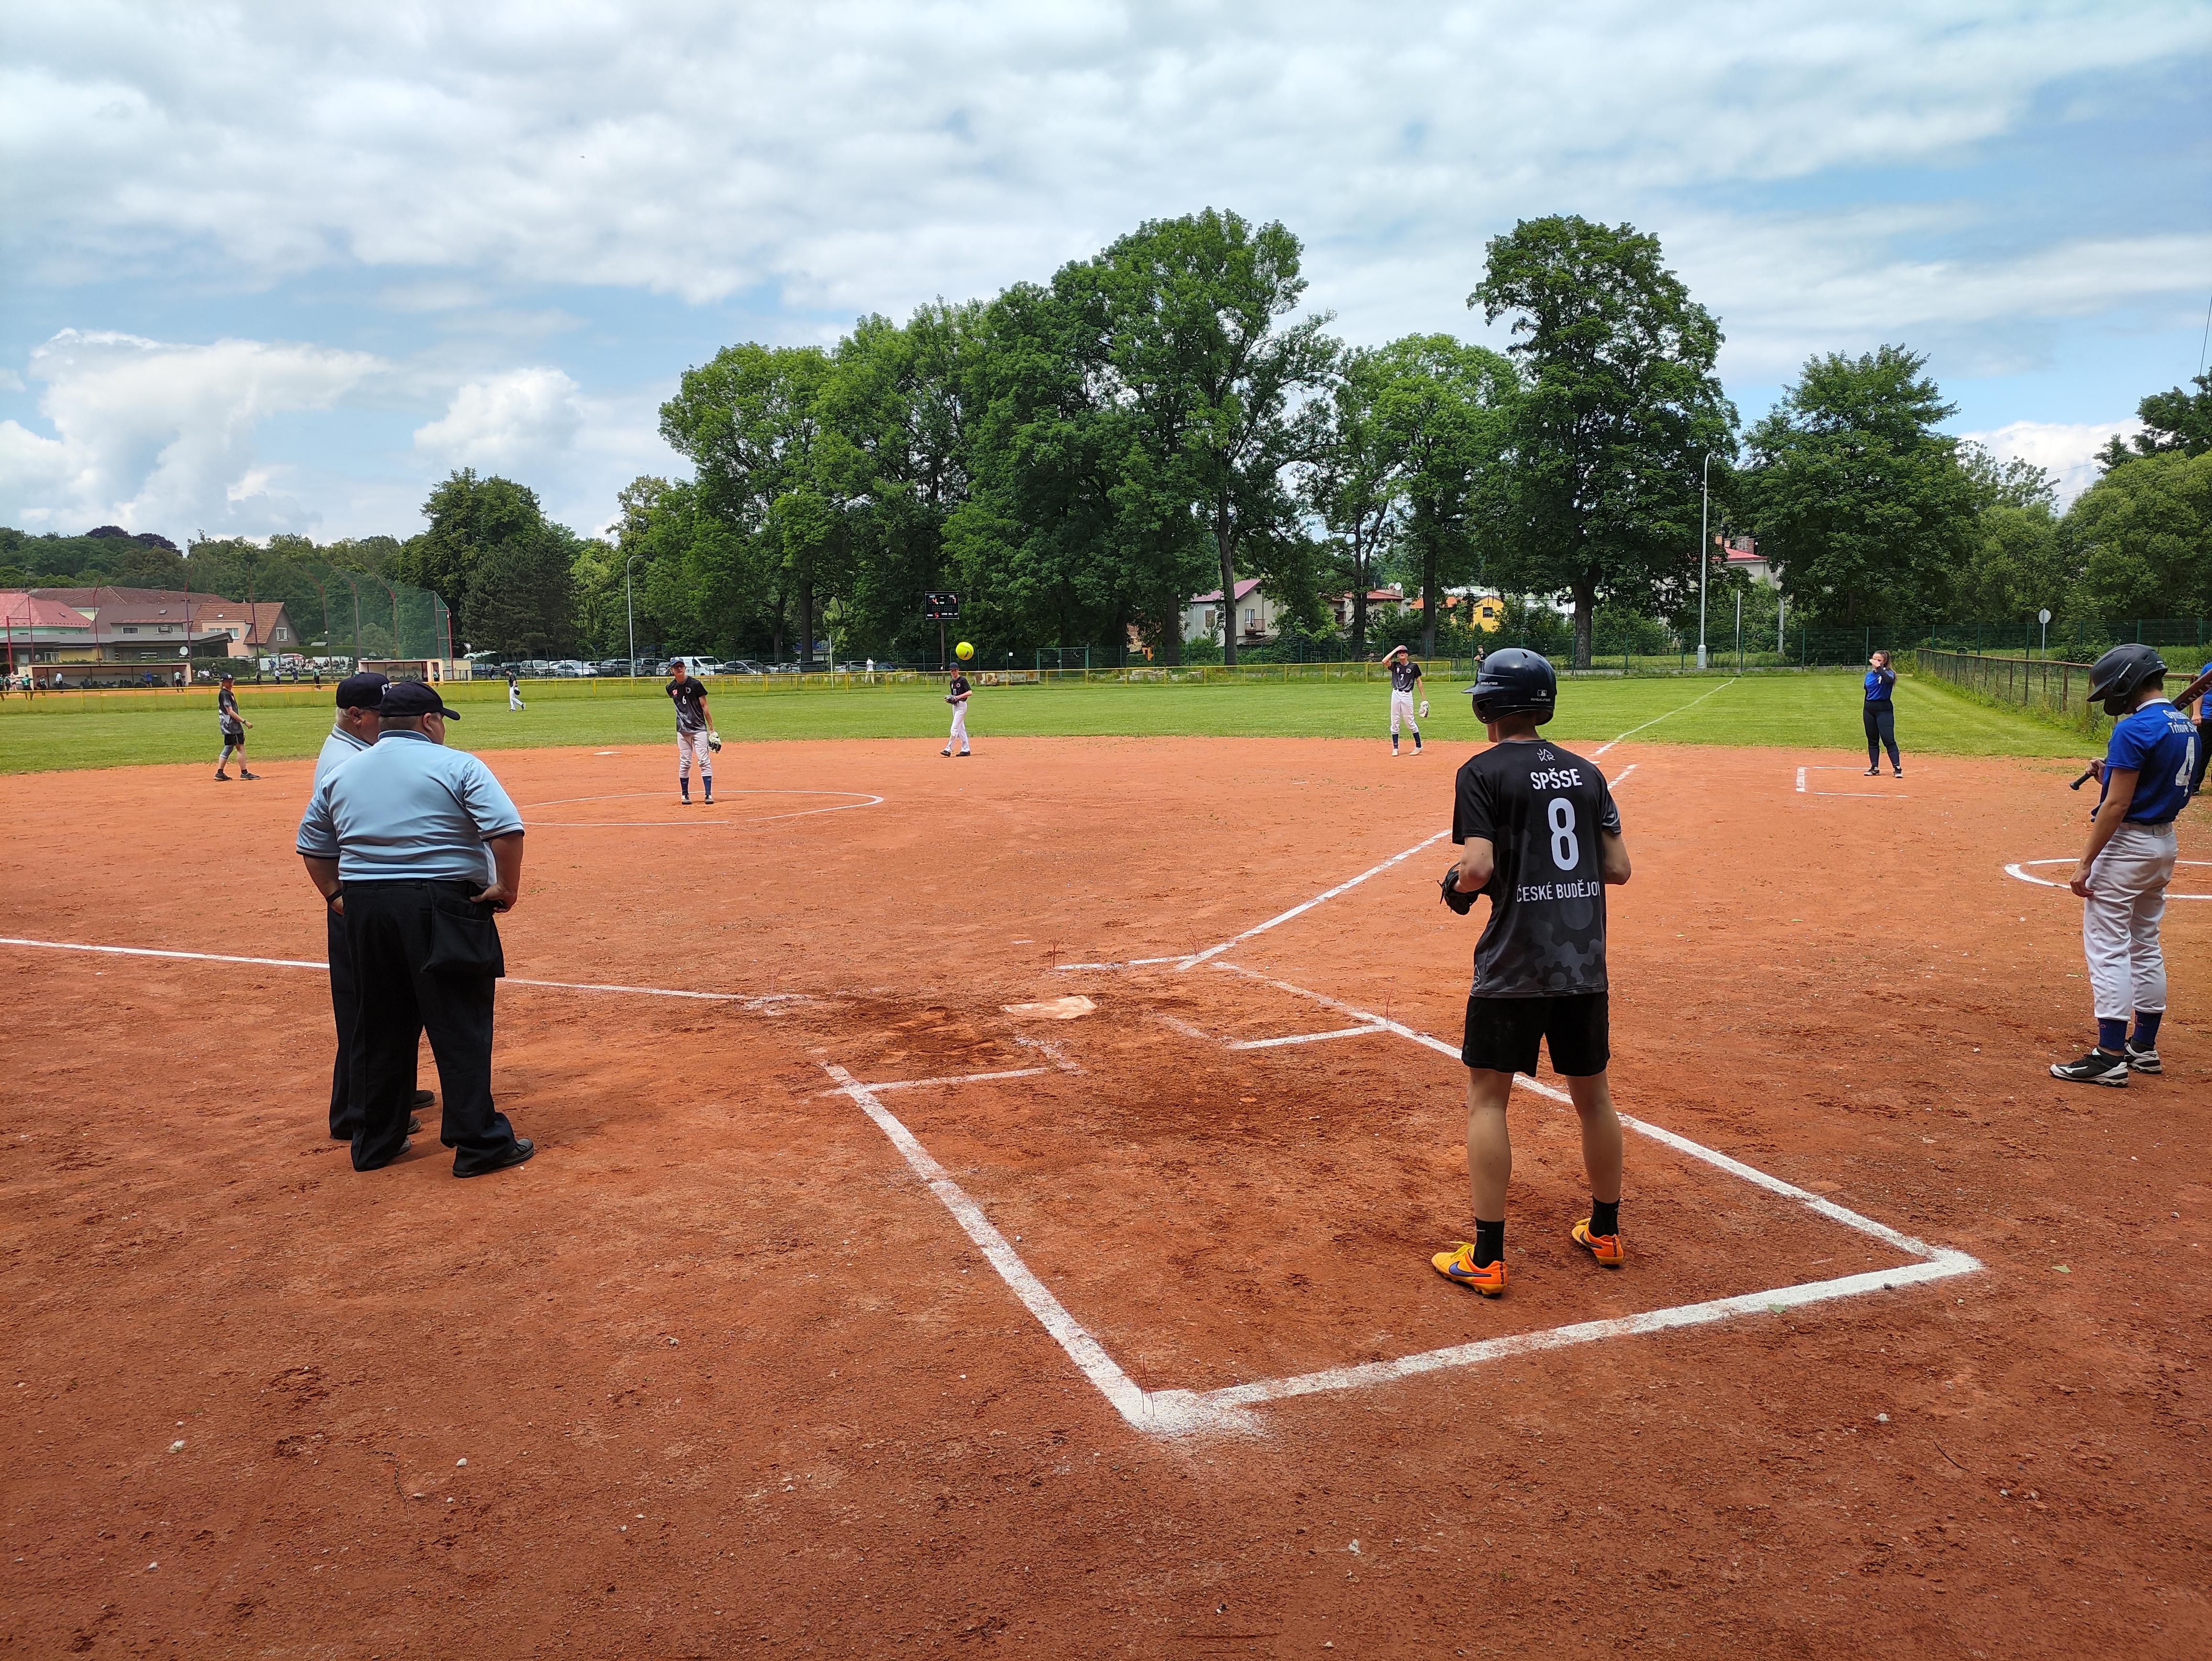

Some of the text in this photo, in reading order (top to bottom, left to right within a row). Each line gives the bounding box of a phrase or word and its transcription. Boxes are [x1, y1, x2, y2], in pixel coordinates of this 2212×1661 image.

[682, 695, 687, 705] 6
[2175, 736, 2195, 797] 4
[1530, 767, 1582, 790] SPŠSE
[1548, 797, 1579, 871] 8
[1516, 881, 1553, 902] ČESKÉ
